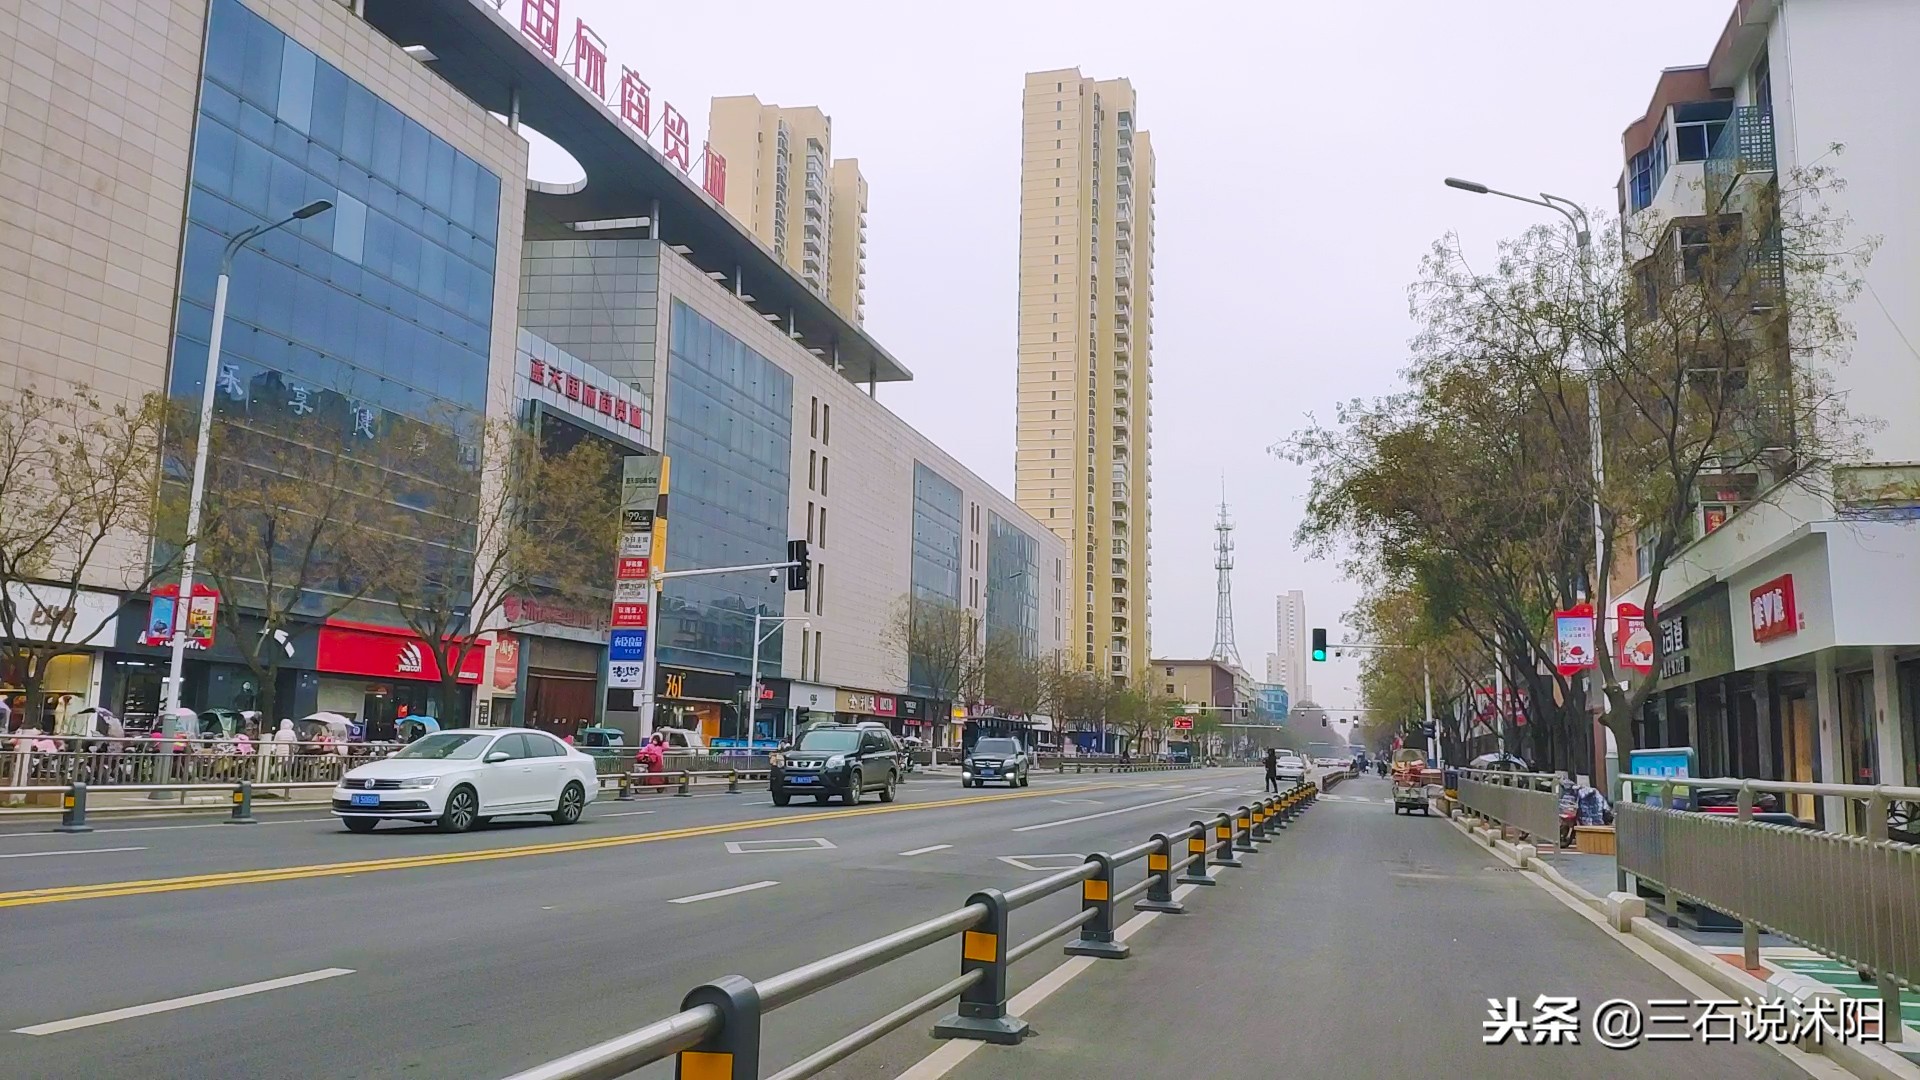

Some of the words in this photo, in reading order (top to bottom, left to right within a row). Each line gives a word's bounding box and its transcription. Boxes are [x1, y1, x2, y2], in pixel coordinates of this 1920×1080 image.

[530, 358, 642, 430] 蓝天国际商贸城
